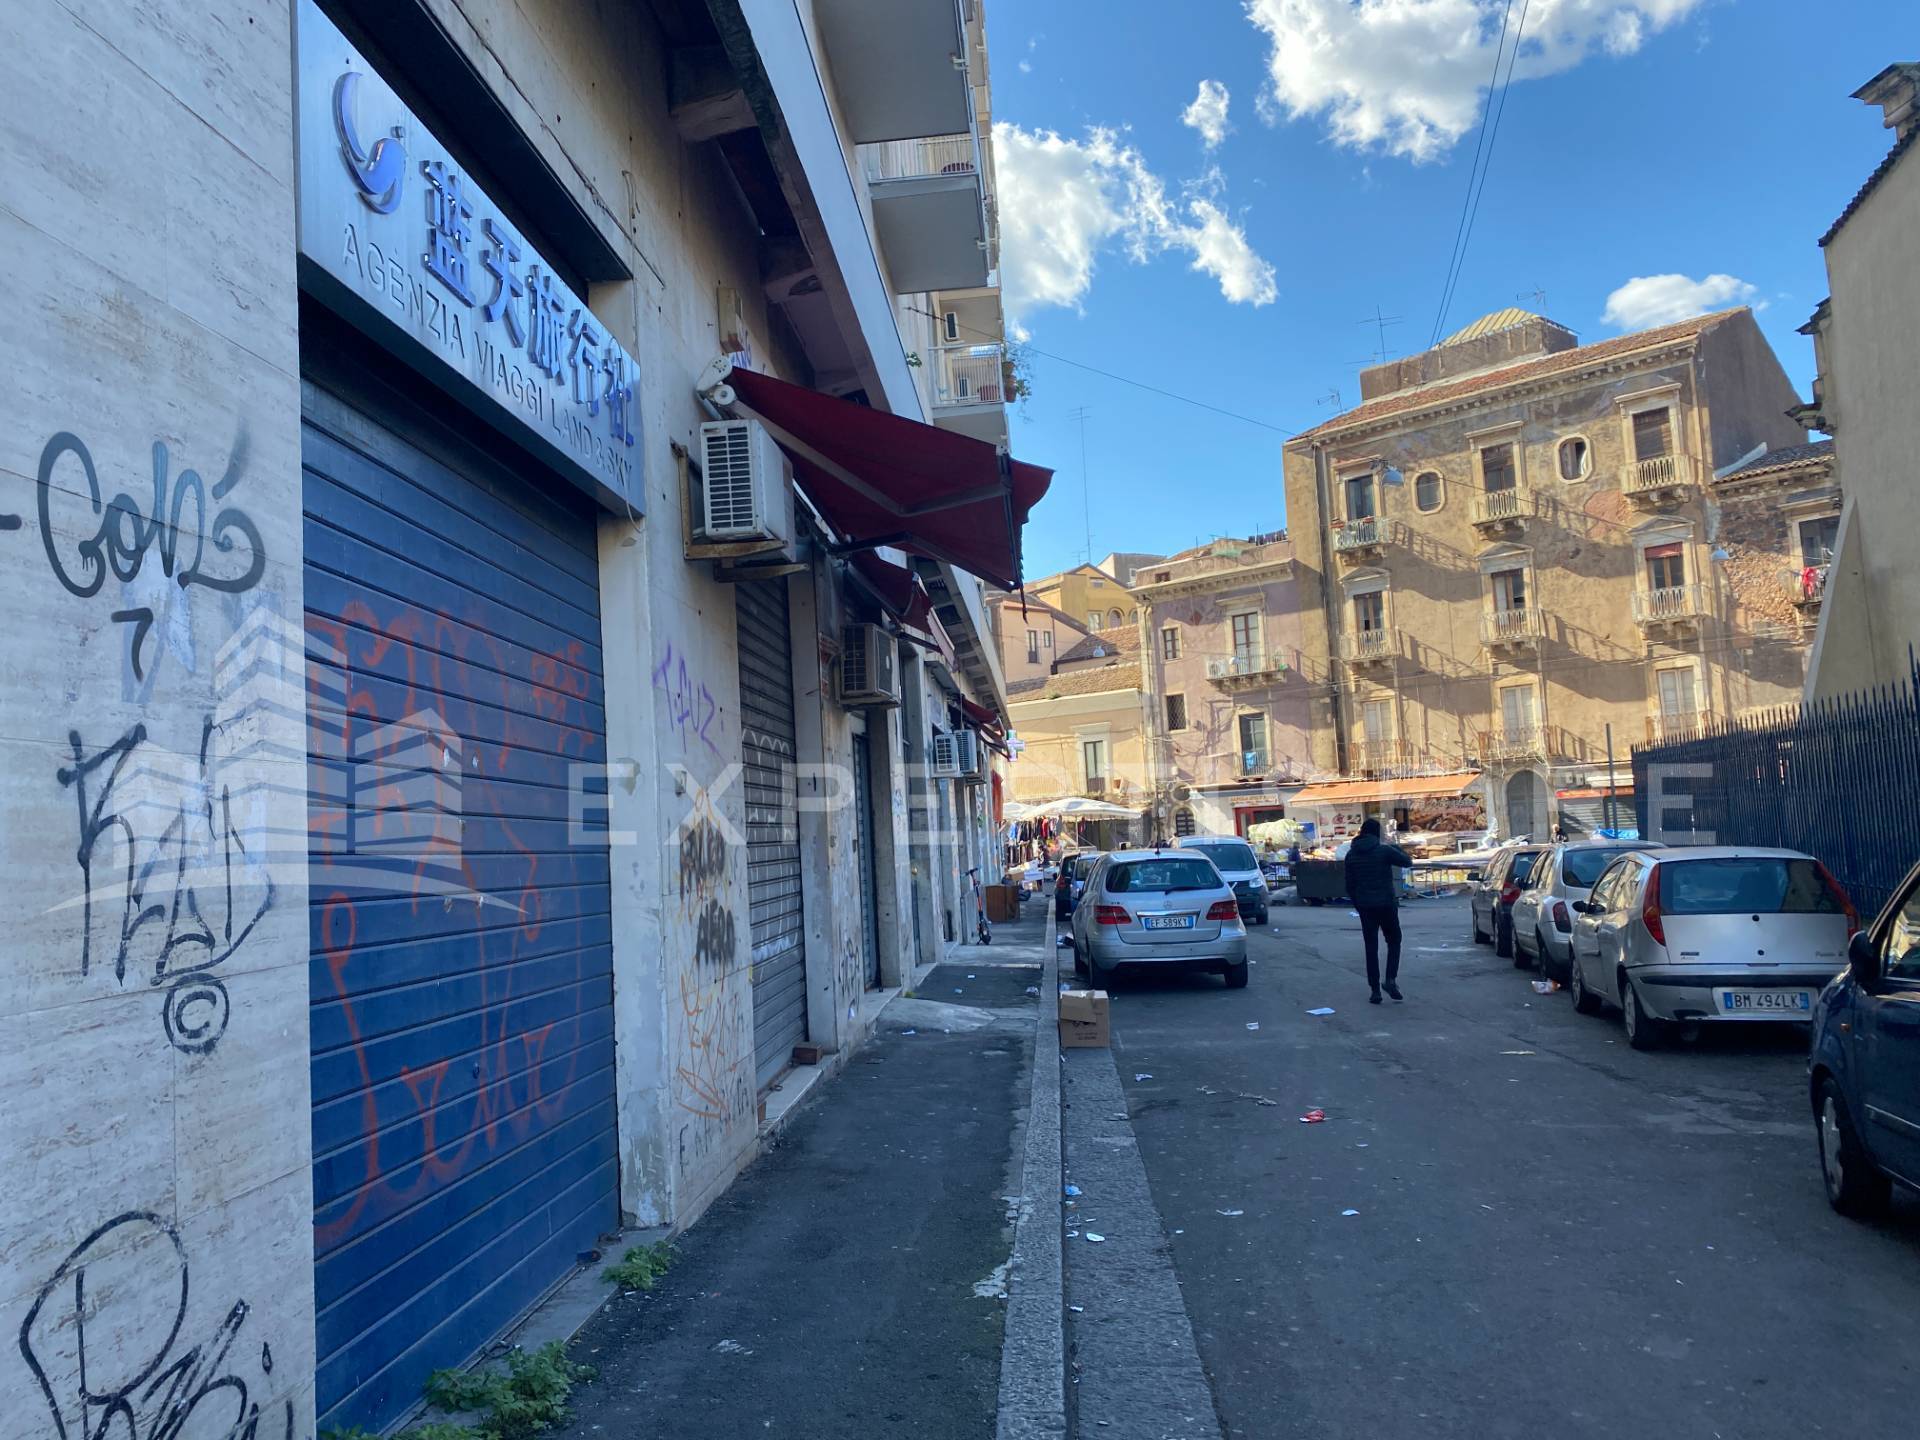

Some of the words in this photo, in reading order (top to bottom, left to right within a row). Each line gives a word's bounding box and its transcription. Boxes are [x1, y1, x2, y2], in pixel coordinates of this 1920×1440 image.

[343, 222, 465, 359] AGENZIA
[474, 331, 543, 422] VIAGGI
[551, 398, 593, 458] LAND
[419, 160, 634, 446] 蓝天旅行社
[1734, 994, 1752, 1009] BM
[1756, 994, 1799, 1009] 494LK
